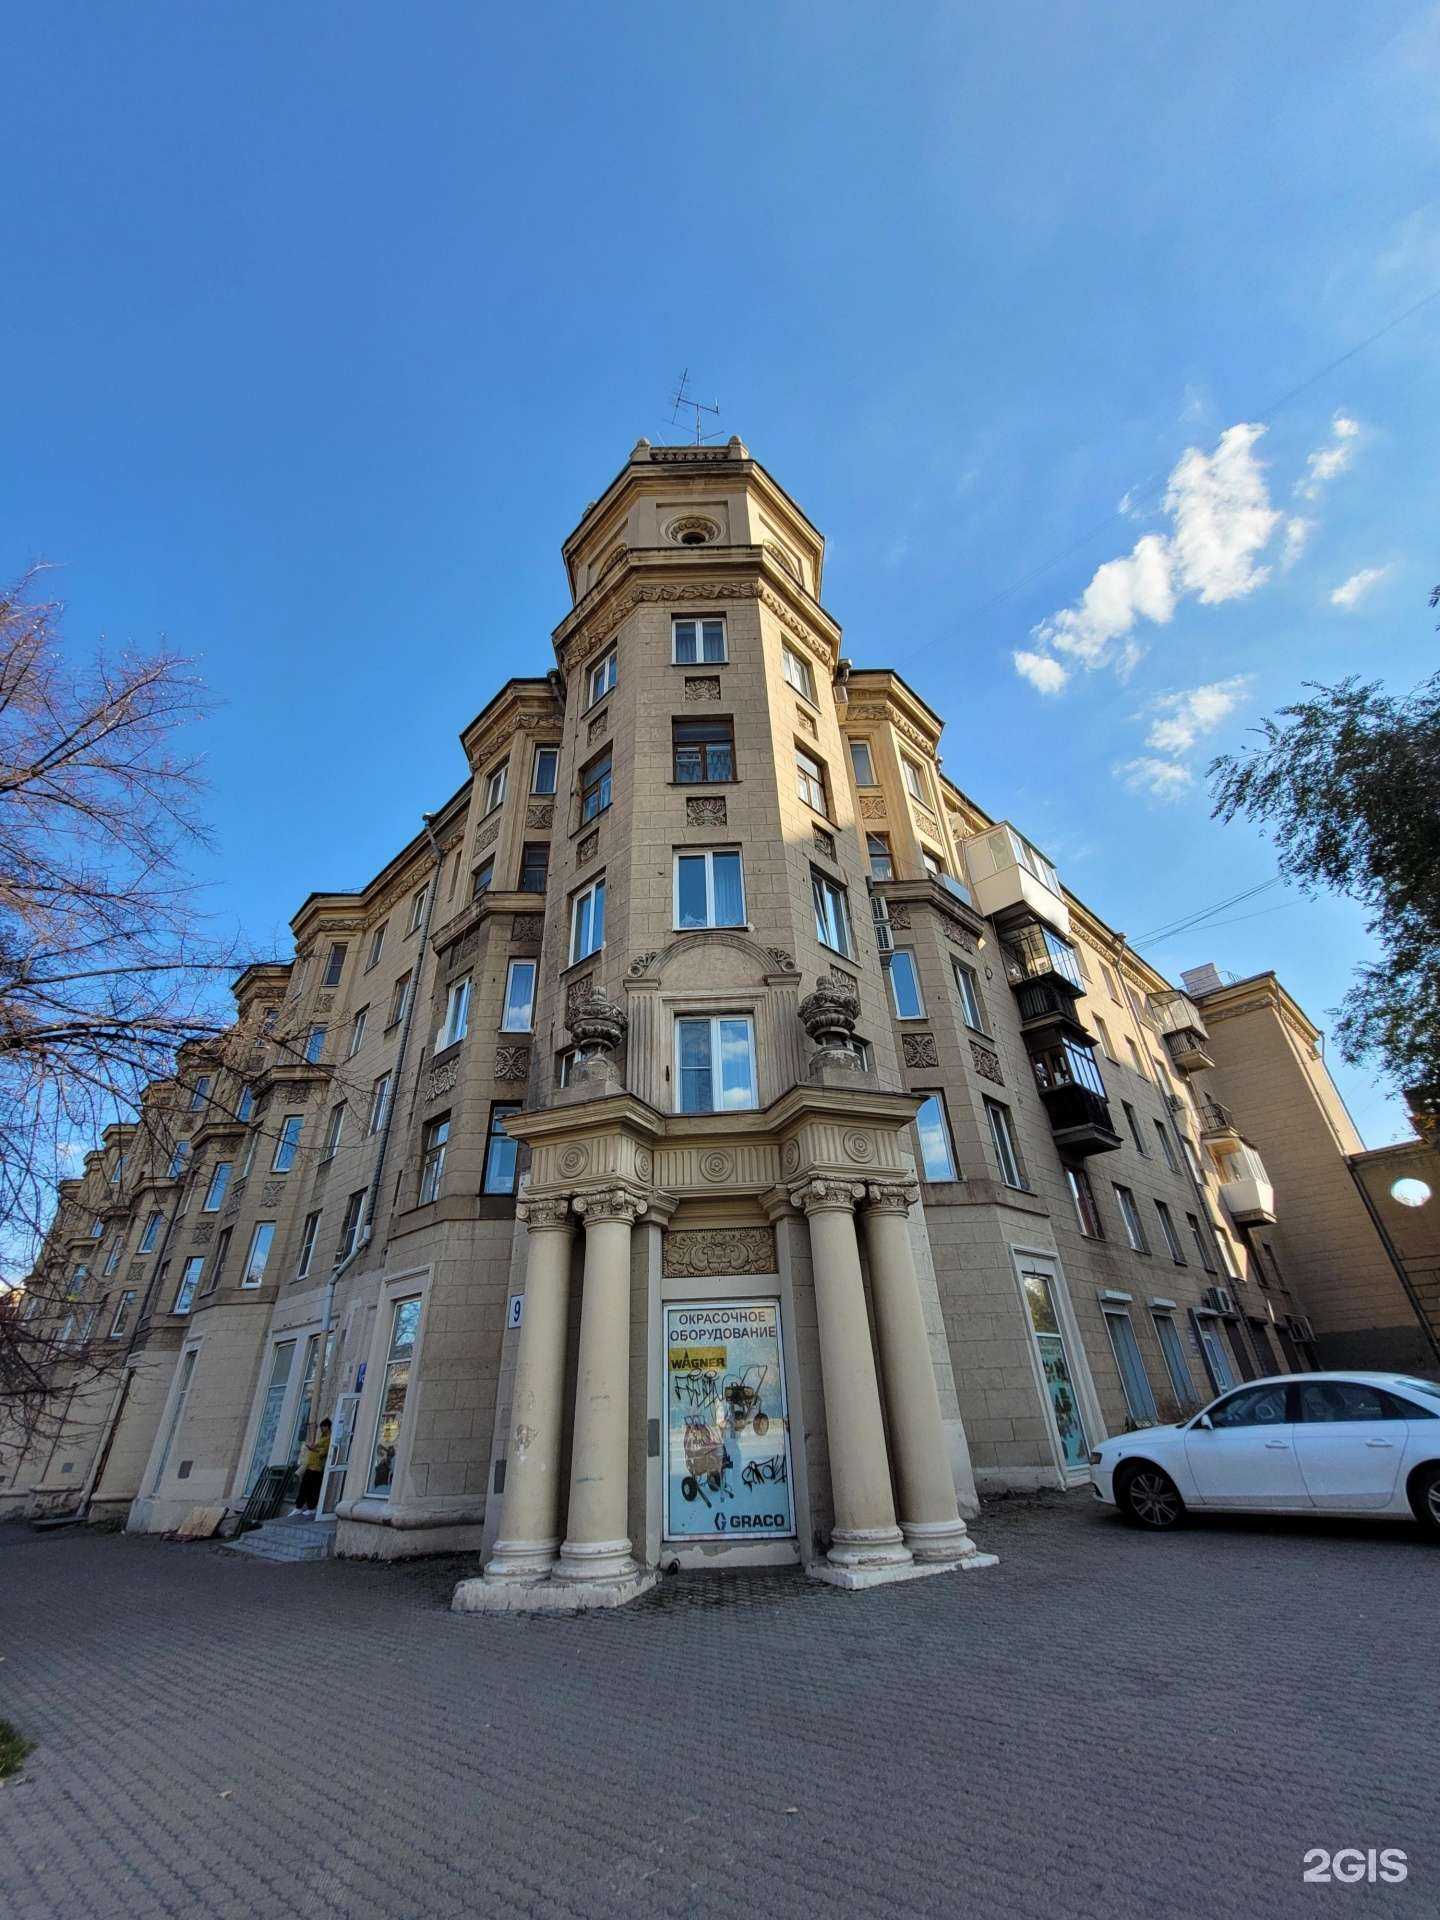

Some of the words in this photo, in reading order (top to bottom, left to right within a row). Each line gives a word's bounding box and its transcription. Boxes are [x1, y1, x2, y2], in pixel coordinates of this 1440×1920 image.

[513, 1300, 521, 1322] 9
[678, 1311, 766, 1325] ОКРАСОЧНОЕ
[670, 1326, 777, 1341] ОБОРУДОВАНИЕ
[671, 1351, 726, 1369] WAGNER
[729, 1513, 785, 1528] GRACO
